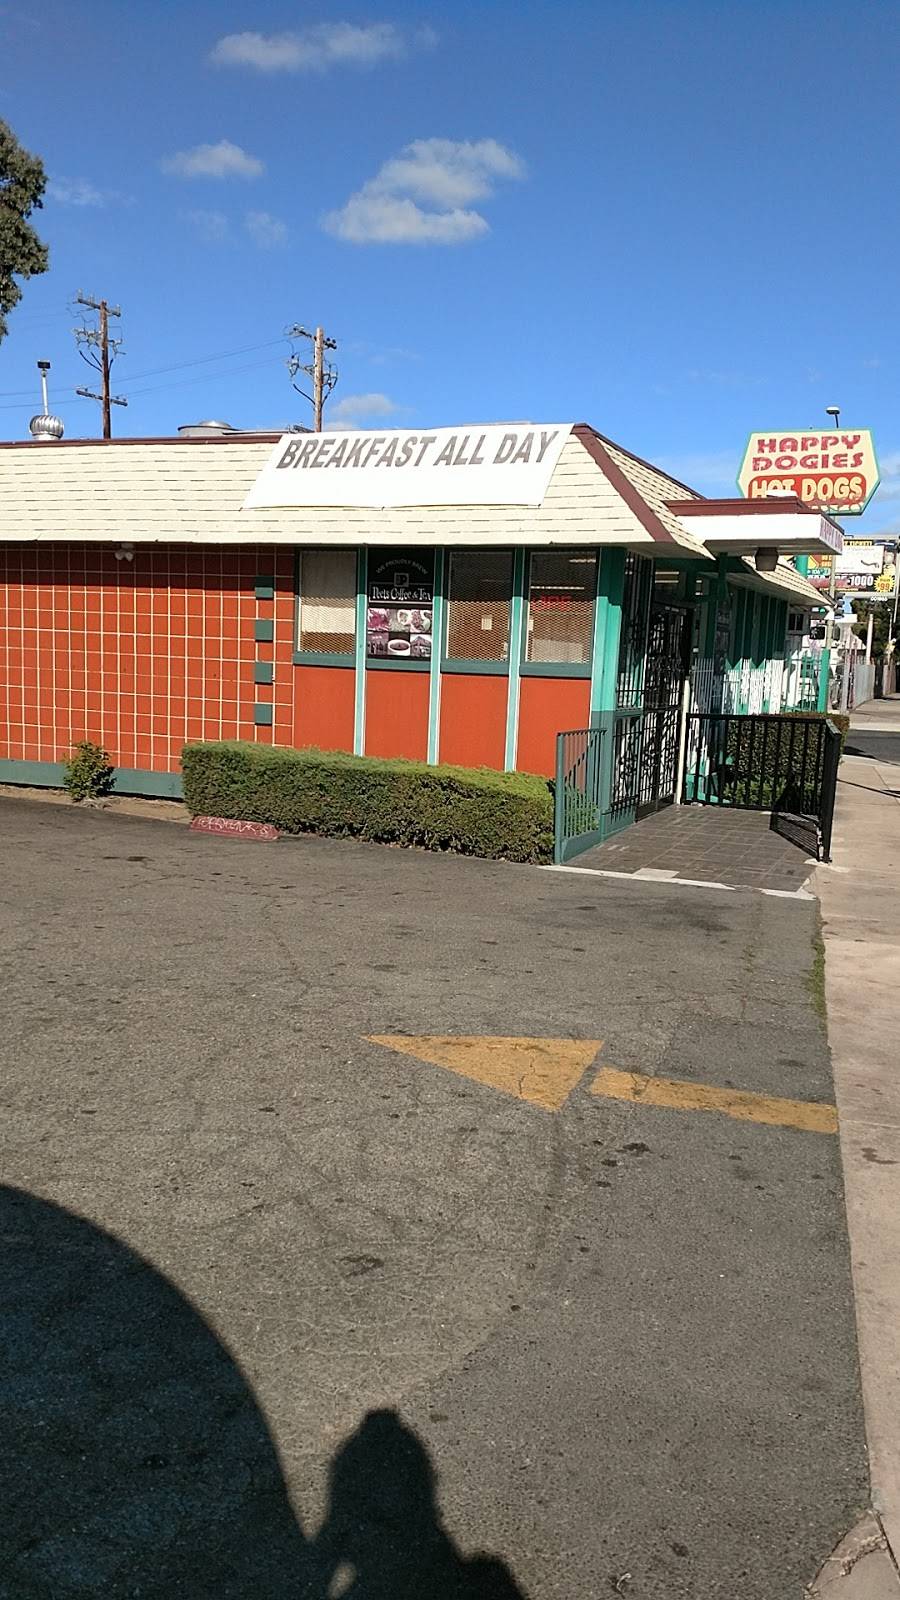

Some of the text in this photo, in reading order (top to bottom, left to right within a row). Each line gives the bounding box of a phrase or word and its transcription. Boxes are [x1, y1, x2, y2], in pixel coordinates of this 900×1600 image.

[275, 430, 559, 469] BREAKFAST ALL DAY
[757, 434, 861, 454] HAPPY
[752, 452, 864, 471] DOGIES
[801, 476, 863, 502] DOGS
[390, 588, 411, 600] Coffee
